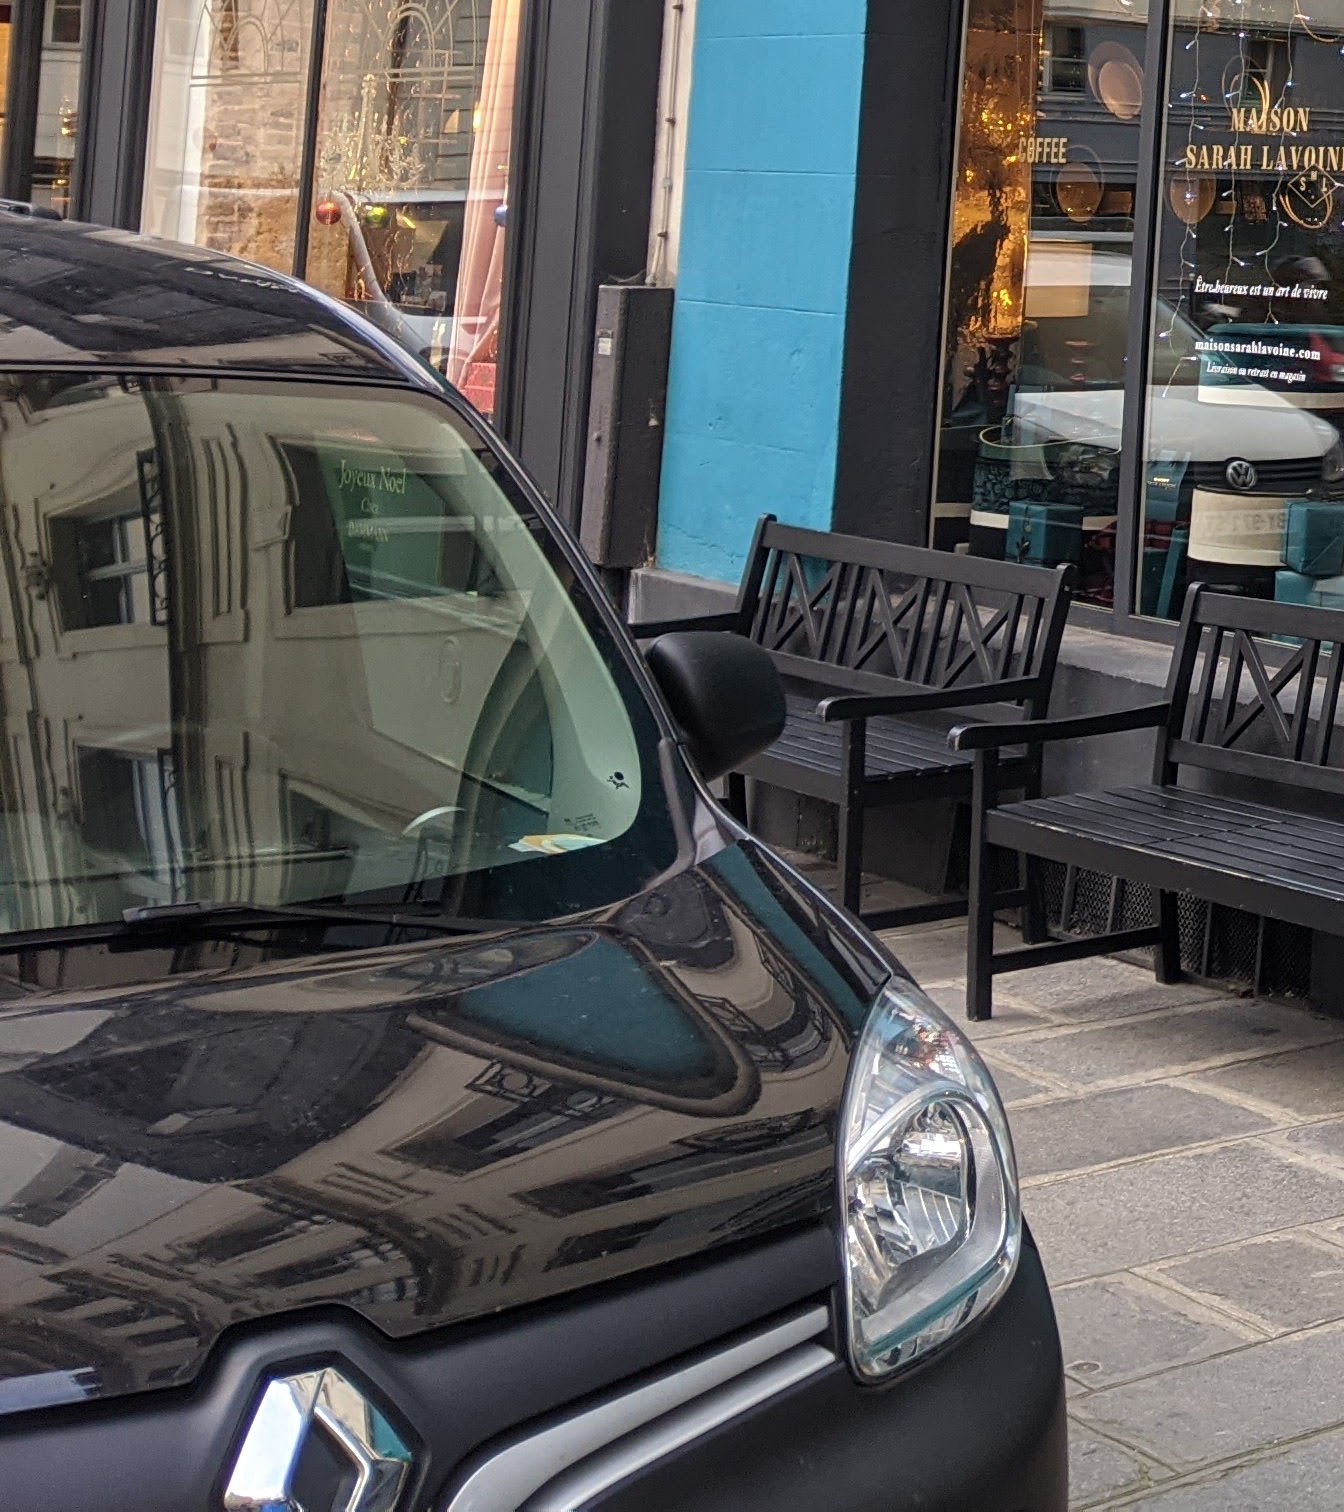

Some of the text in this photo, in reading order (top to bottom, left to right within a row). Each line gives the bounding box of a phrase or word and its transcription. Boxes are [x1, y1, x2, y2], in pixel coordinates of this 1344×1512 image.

[1230, 107, 1311, 133] MAISON
[1018, 138, 1068, 164] COFFEE
[1186, 144, 1253, 171] SARAH
[1194, 275, 1329, 300] Être heureux est un art de vivre
[1195, 340, 1321, 361] maisonsarahlavoine.com
[339, 459, 376, 492] Joyeux
